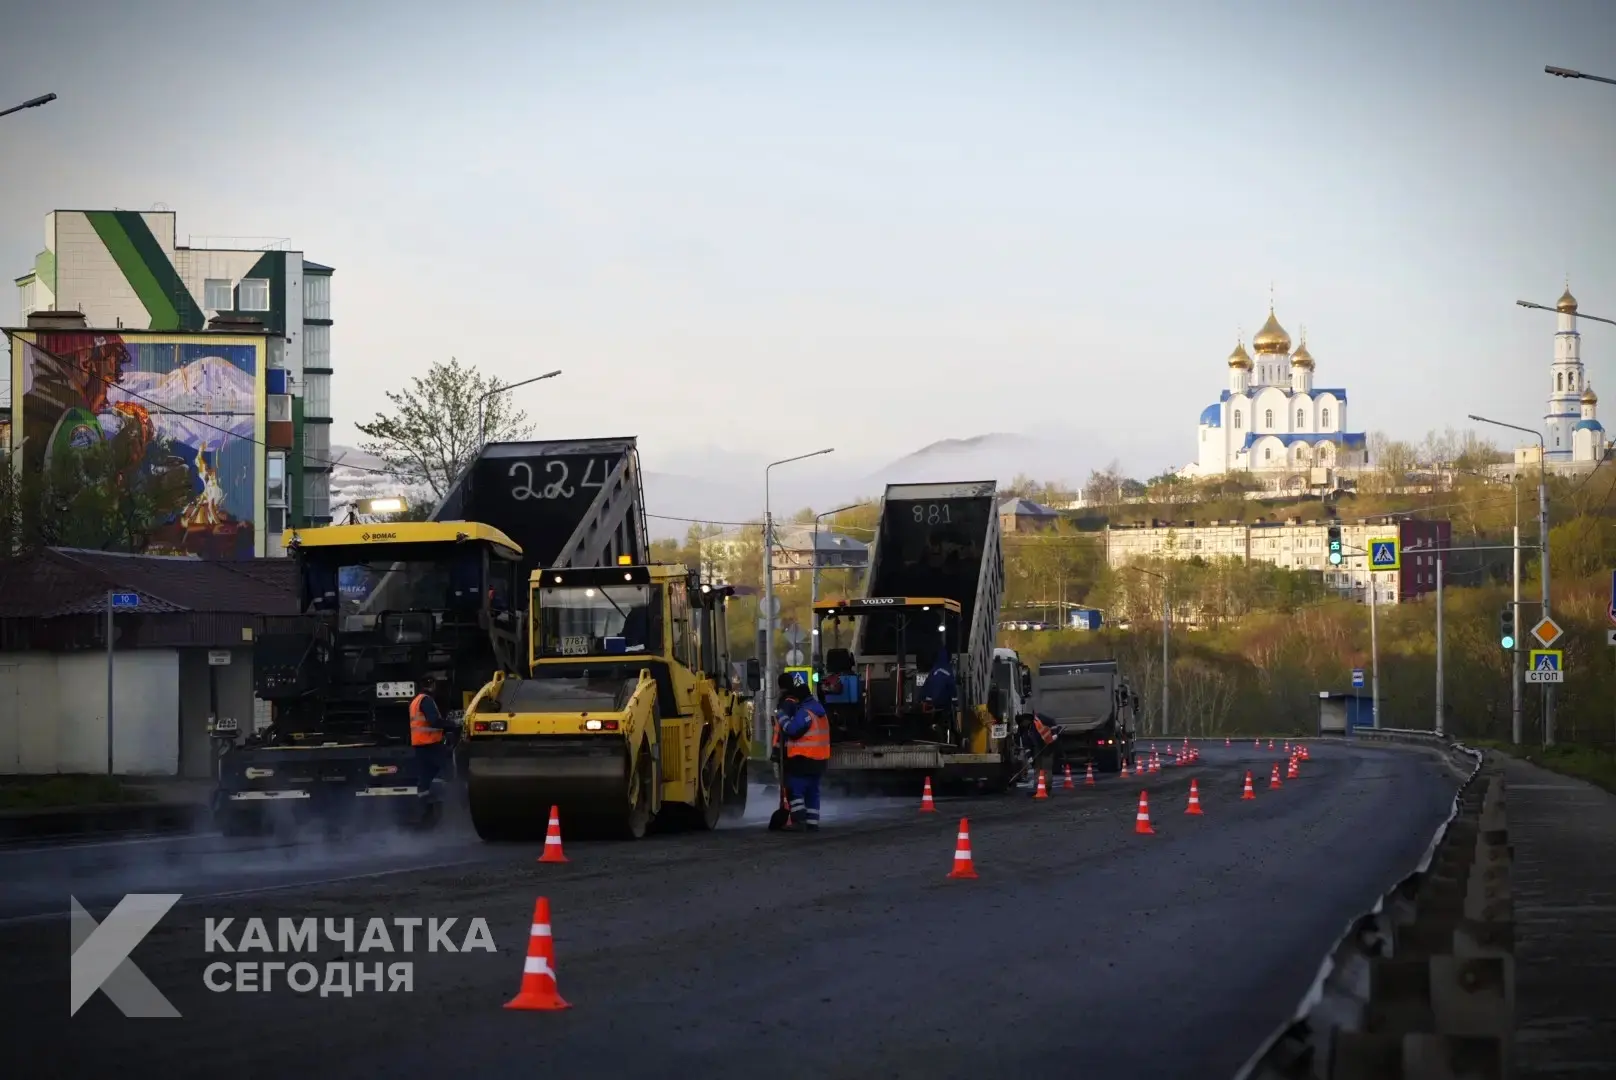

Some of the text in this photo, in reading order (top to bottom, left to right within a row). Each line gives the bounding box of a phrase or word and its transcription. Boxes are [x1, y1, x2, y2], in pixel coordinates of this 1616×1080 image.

[508, 459, 608, 500] 224
[912, 504, 952, 525] 881
[372, 532, 397, 540] BOMAG
[120, 595, 130, 603] 10
[564, 636, 585, 646] 7787
[1530, 672, 1558, 681] СТОП
